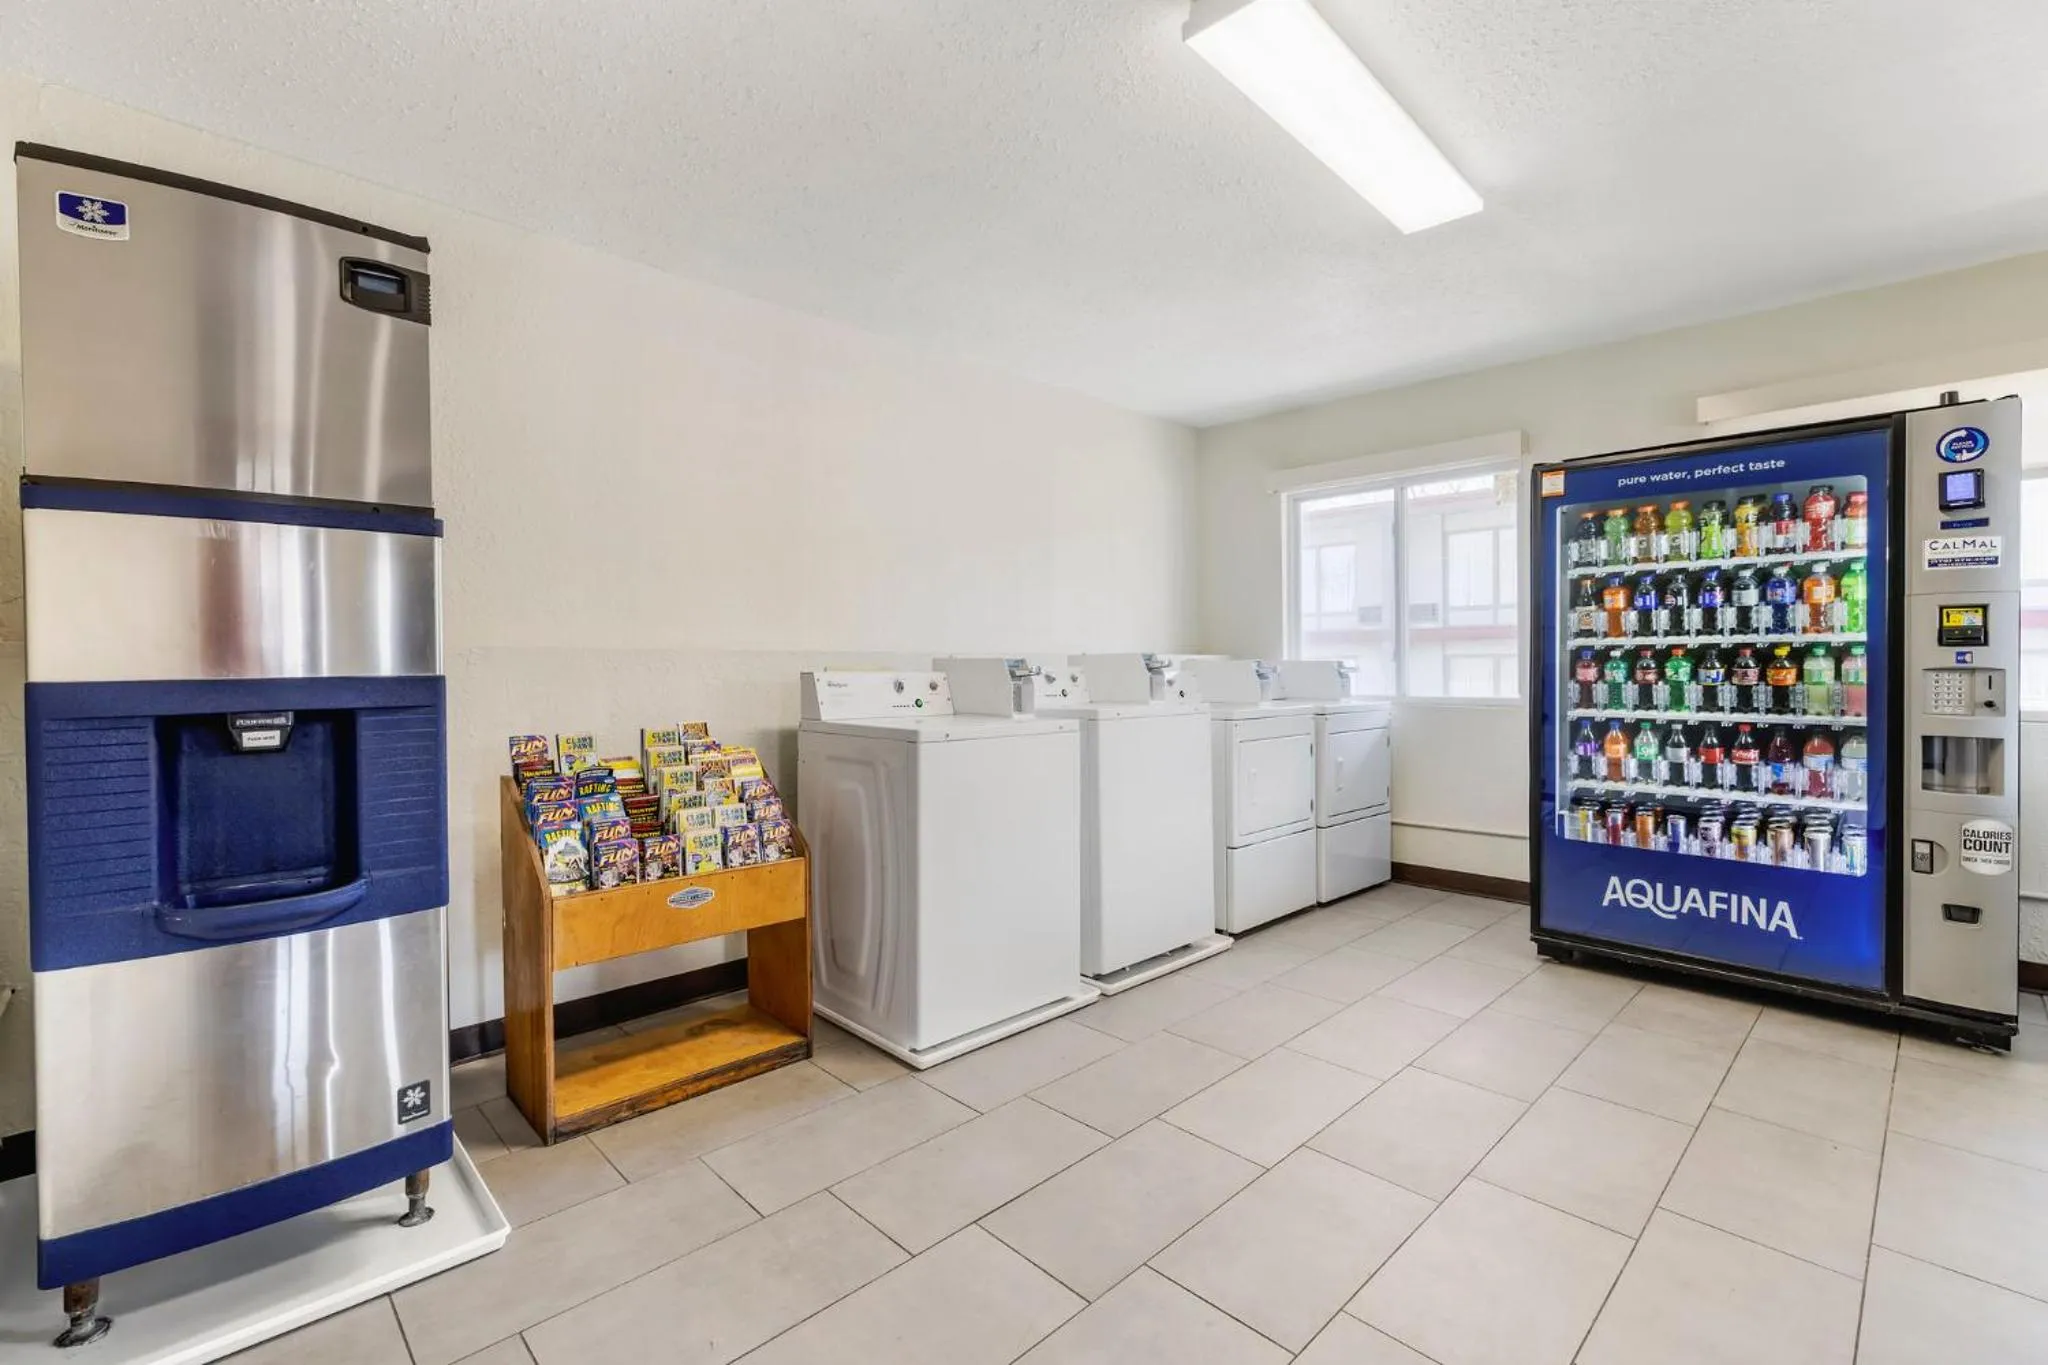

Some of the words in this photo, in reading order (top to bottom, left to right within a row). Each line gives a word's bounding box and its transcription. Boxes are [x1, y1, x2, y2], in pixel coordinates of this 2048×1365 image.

[1618, 475, 1647, 487] pure
[1650, 470, 1691, 482] water,
[1694, 462, 1744, 478] perfect
[1748, 458, 1785, 471] taste
[533, 788, 572, 803] FUN
[579, 783, 612, 796] RAFTING
[537, 807, 576, 826] FUN
[594, 824, 629, 842] FUN
[1962, 828, 2012, 841] CALORIES
[646, 840, 681, 857] FUN
[1963, 838, 2012, 854] COUNT
[599, 847, 638, 867] FUN
[1602, 875, 1802, 940] AQUAFINA
